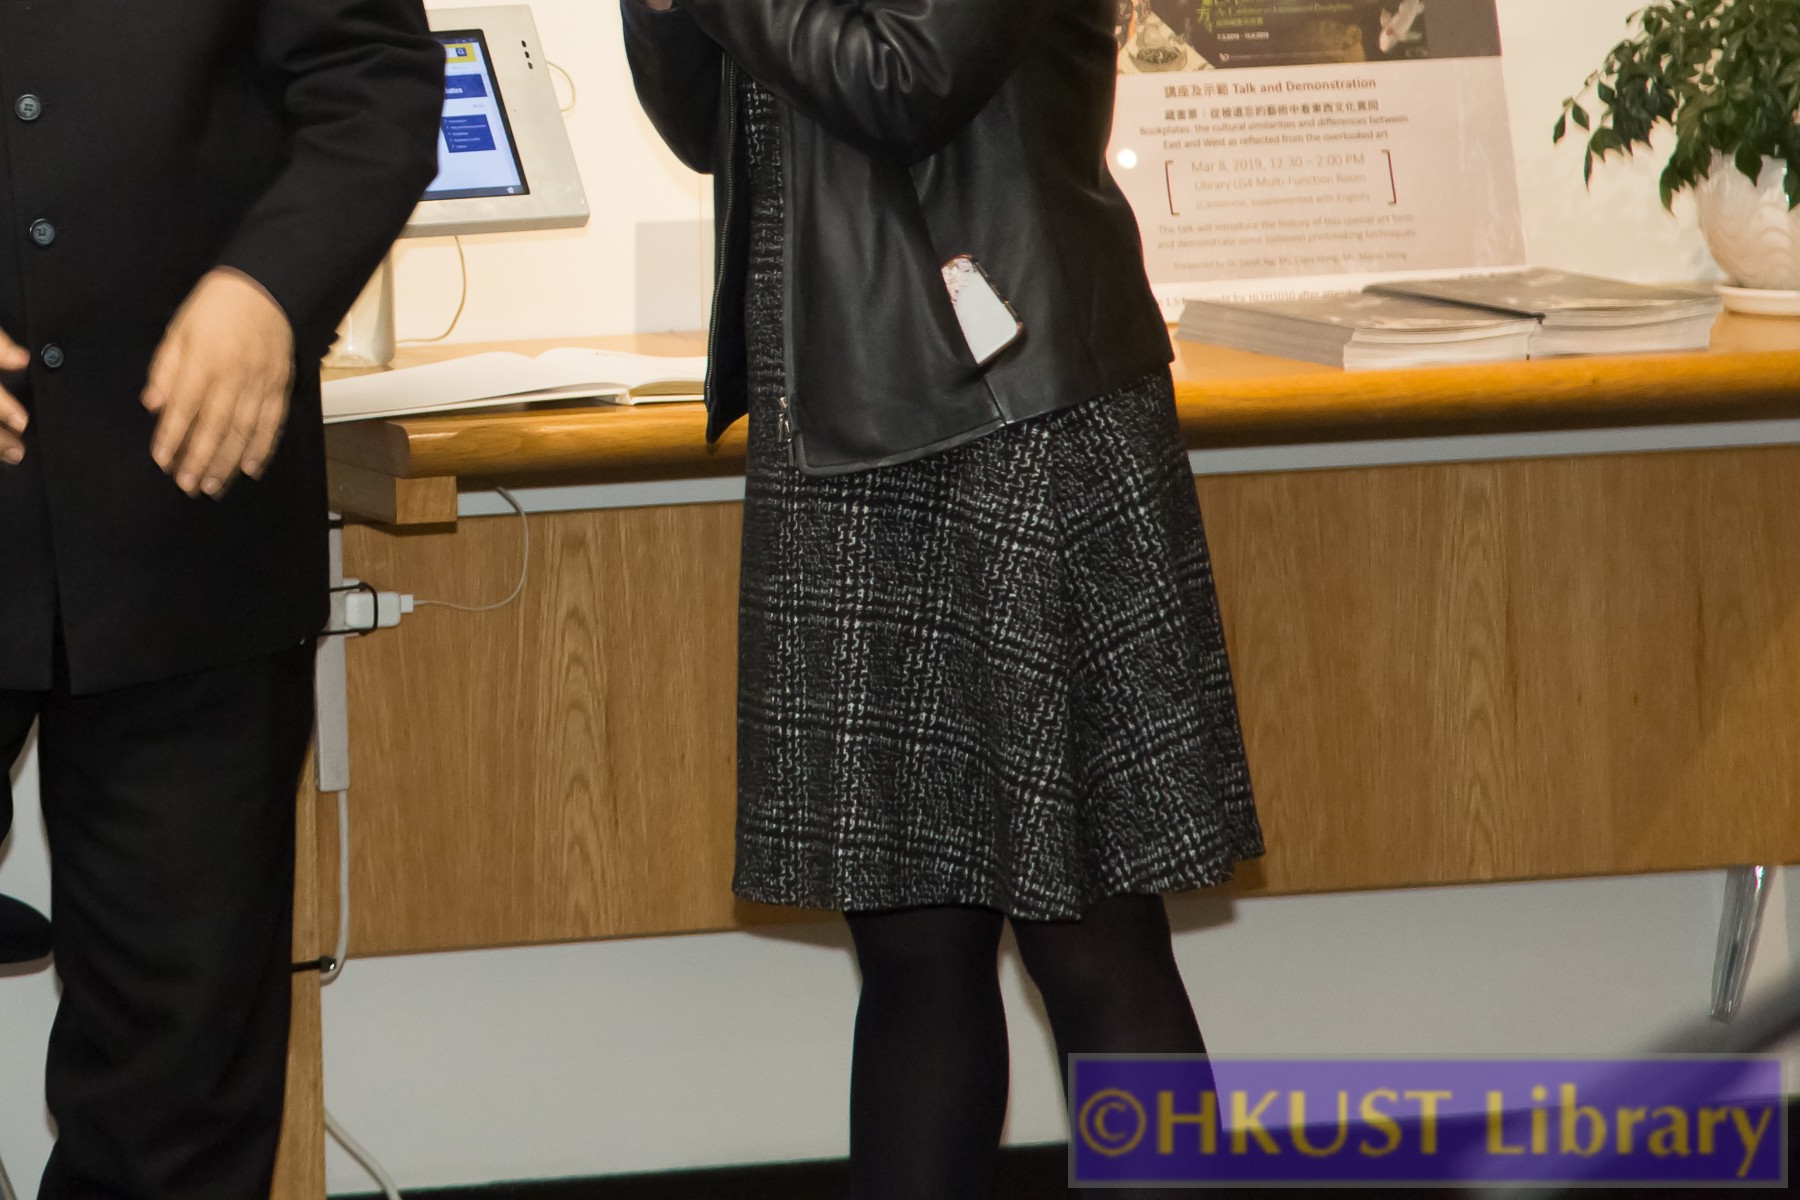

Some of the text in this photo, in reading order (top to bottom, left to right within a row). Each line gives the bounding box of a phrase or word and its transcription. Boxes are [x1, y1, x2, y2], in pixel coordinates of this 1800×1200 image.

[1233, 83, 1256, 94] Talk
[1260, 82, 1282, 92] and
[1286, 79, 1377, 92] Demonstration
